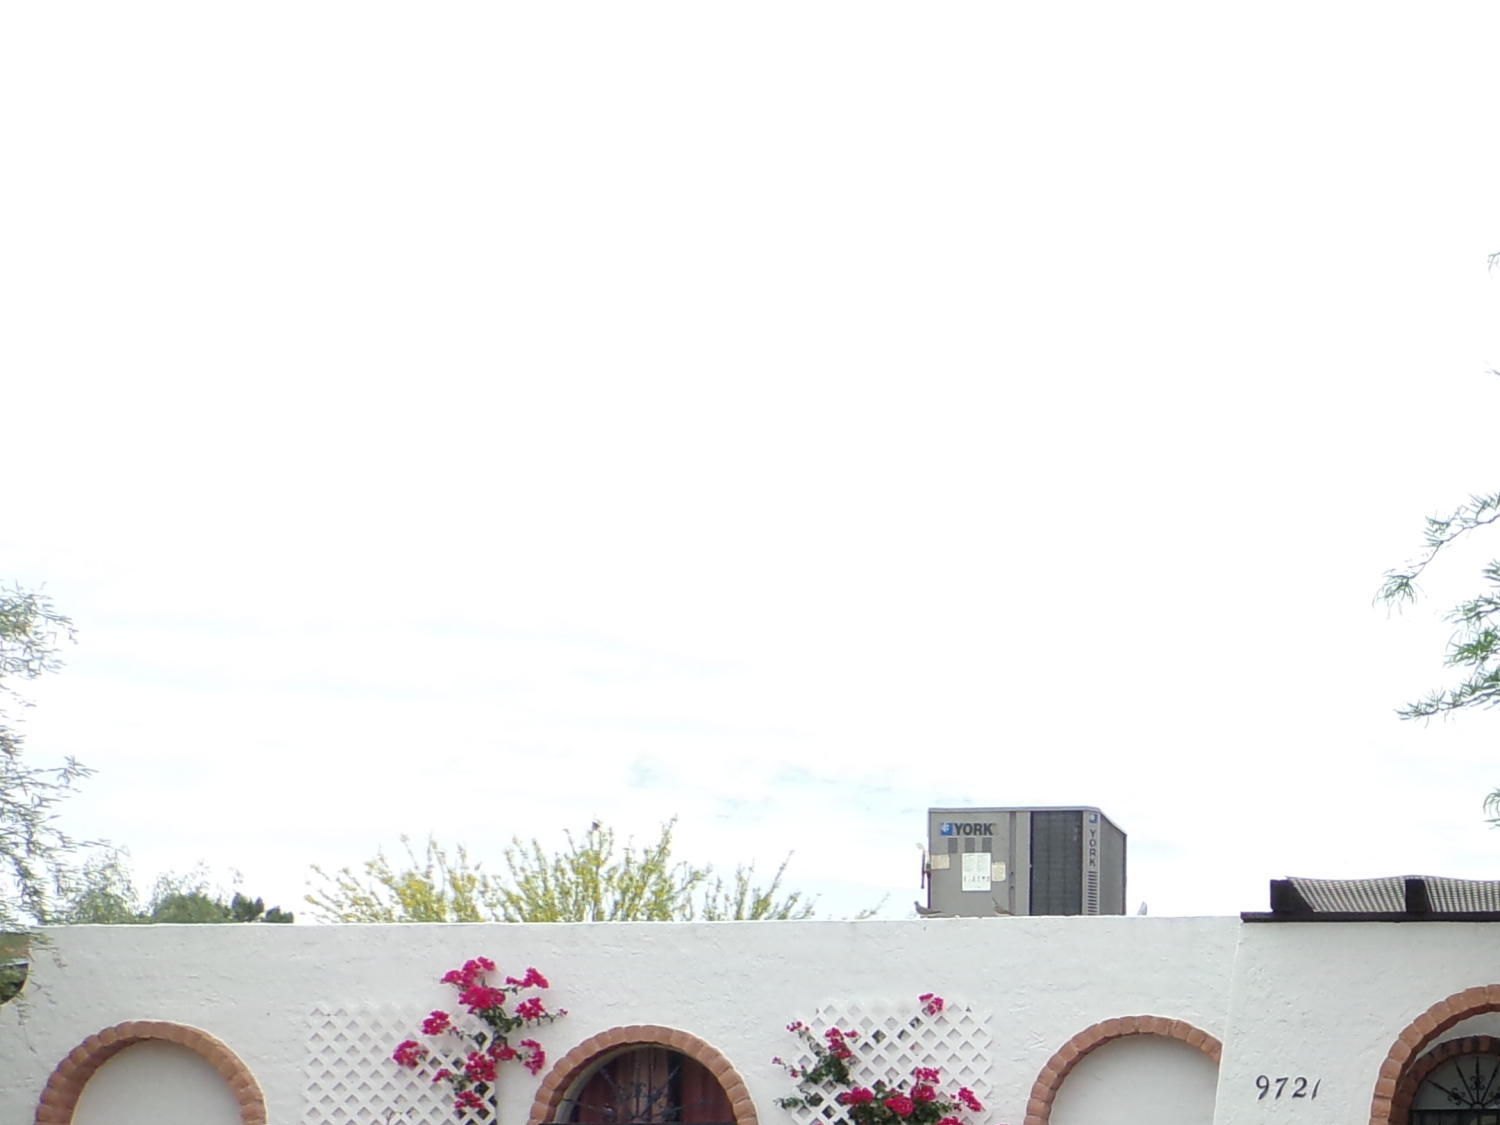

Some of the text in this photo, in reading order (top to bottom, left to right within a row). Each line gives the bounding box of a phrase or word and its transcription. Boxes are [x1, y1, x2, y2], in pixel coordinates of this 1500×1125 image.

[954, 823, 994, 836] YORK
[1088, 827, 1098, 867] YORK
[1255, 1074, 1322, 1101] 9721
